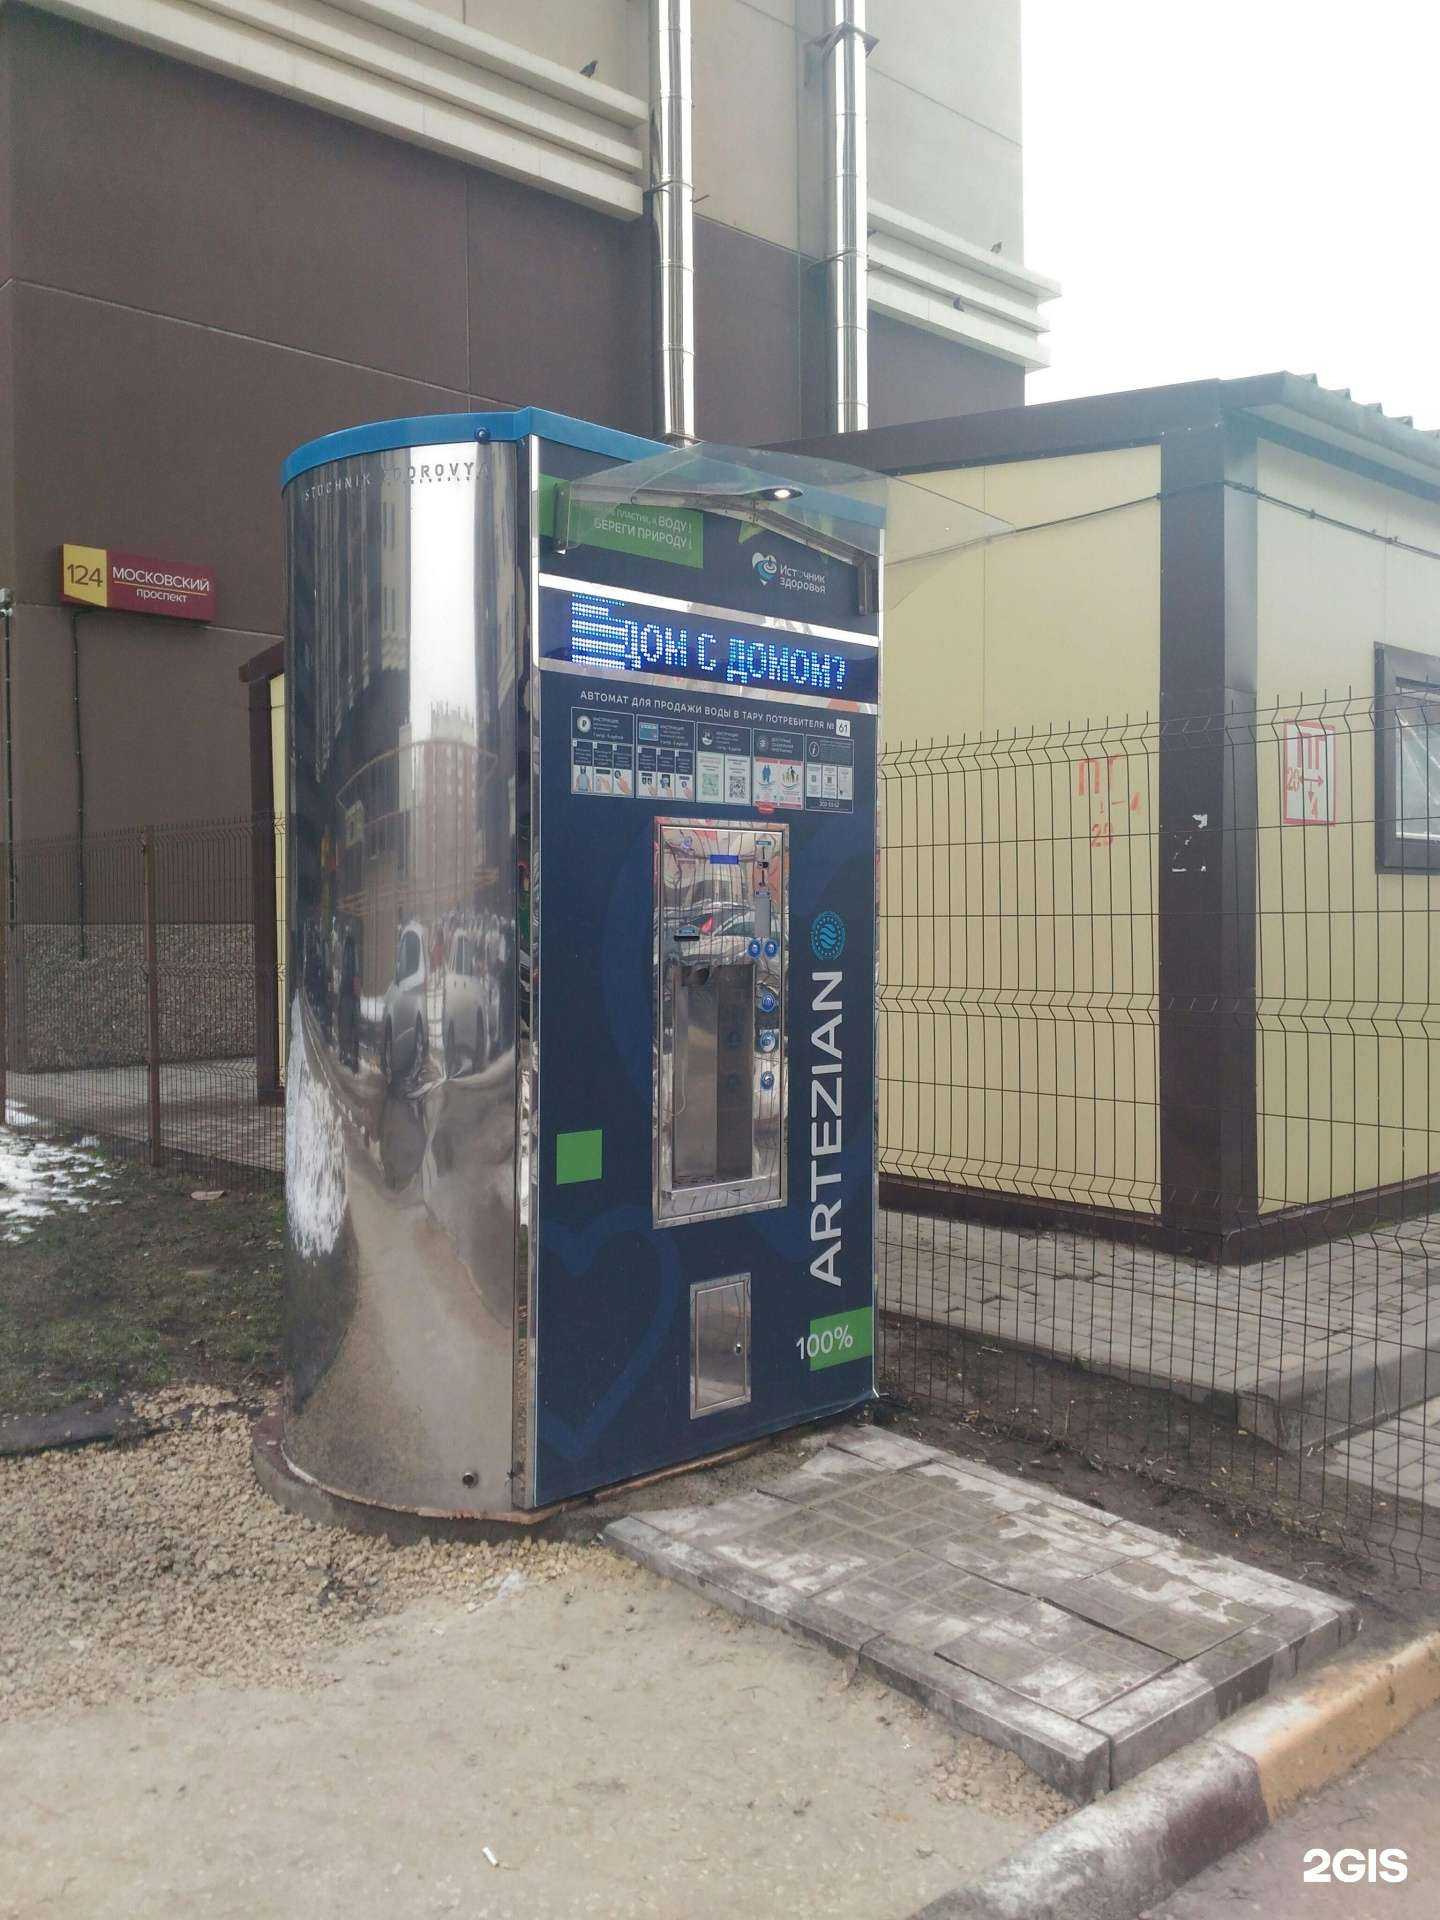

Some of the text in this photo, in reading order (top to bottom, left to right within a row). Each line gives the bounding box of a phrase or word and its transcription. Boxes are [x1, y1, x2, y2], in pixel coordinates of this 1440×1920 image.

[594, 516, 636, 537] БЕРЕГИ
[67, 564, 103, 588] 124
[112, 566, 210, 592] МОСКОВСКИЙ
[136, 587, 187, 603] проспект
[697, 632, 717, 672] С
[726, 637, 846, 690] ДОМОМ?
[580, 690, 629, 704] АВТОМАТ
[631, 697, 652, 708] ДЛЯ
[654, 699, 702, 714] ПРОДАЖИ
[704, 706, 731, 719] ВОДЫ
[733, 709, 740, 719] В
[742, 711, 764, 721] ТАРУ
[766, 713, 825, 729] ПОТРЕБИТЕЛЯ
[810, 971, 844, 1288] ARTEZIAN
[796, 1324, 854, 1360] 100%
